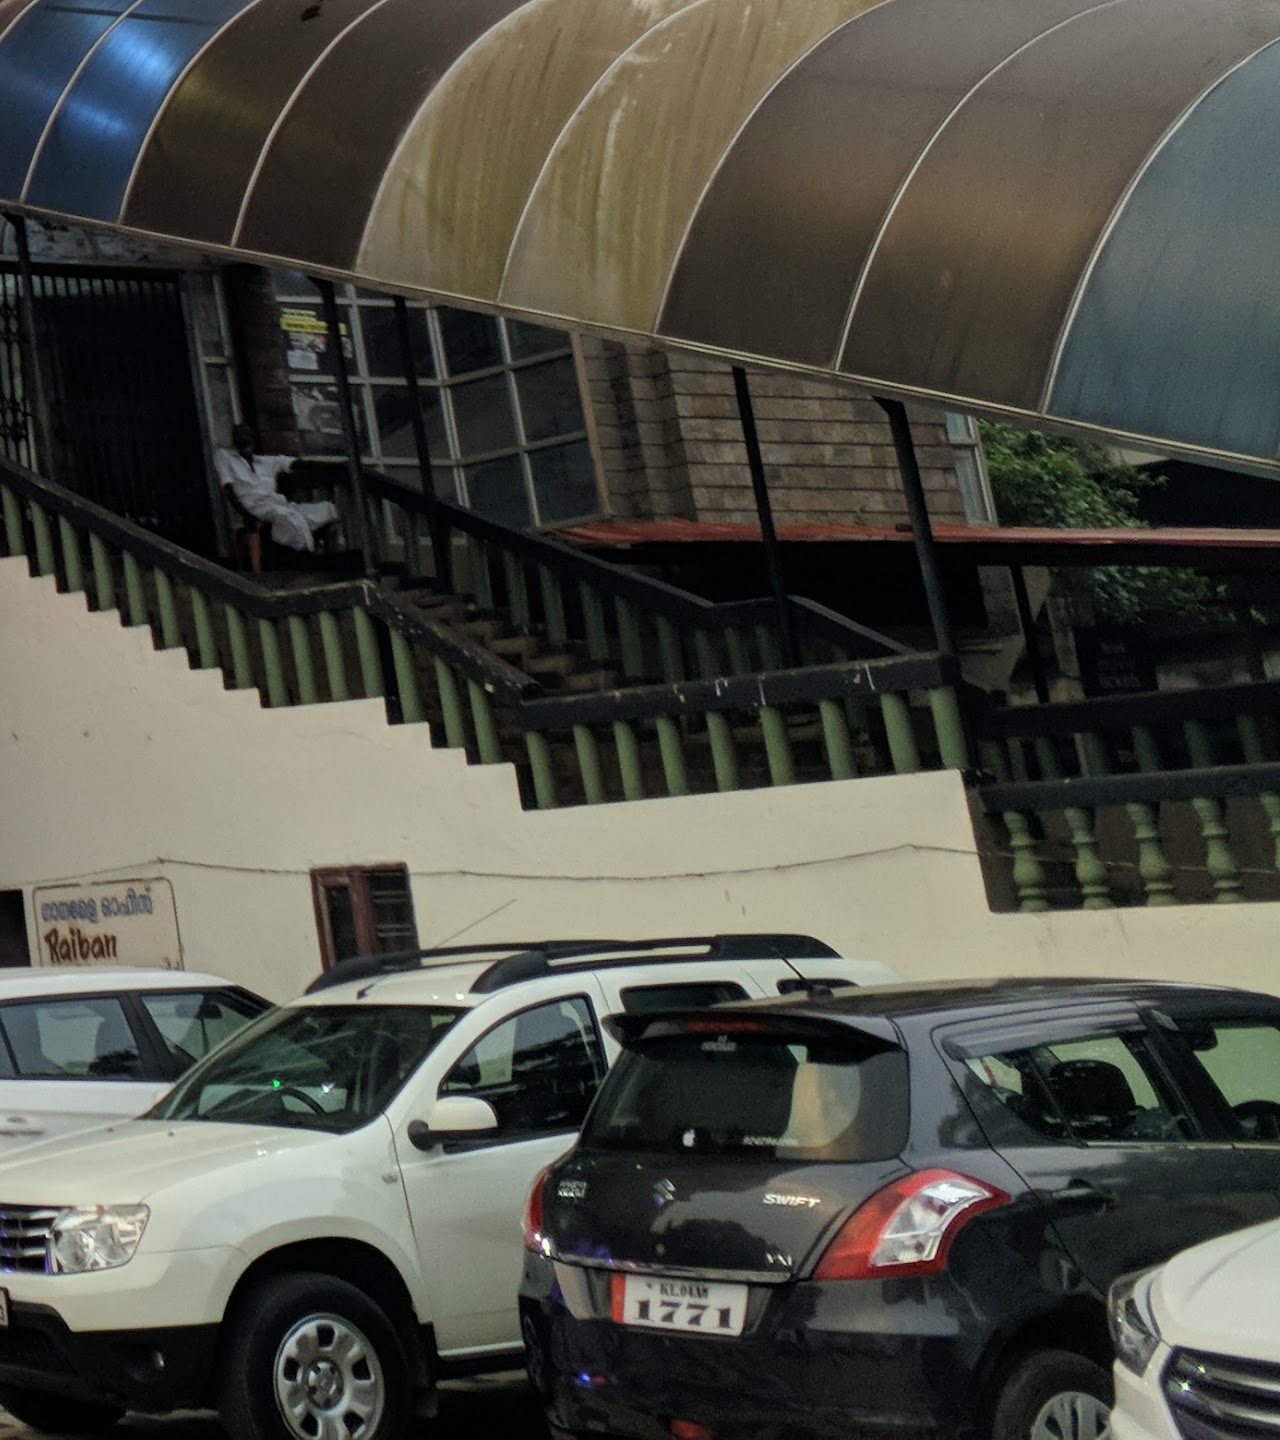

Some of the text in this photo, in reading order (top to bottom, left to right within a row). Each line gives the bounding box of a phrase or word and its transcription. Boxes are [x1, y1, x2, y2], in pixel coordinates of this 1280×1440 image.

[44, 927, 119, 963] Raiban
[762, 1193, 822, 1208] SWIFT
[633, 1299, 735, 1330] 1771
